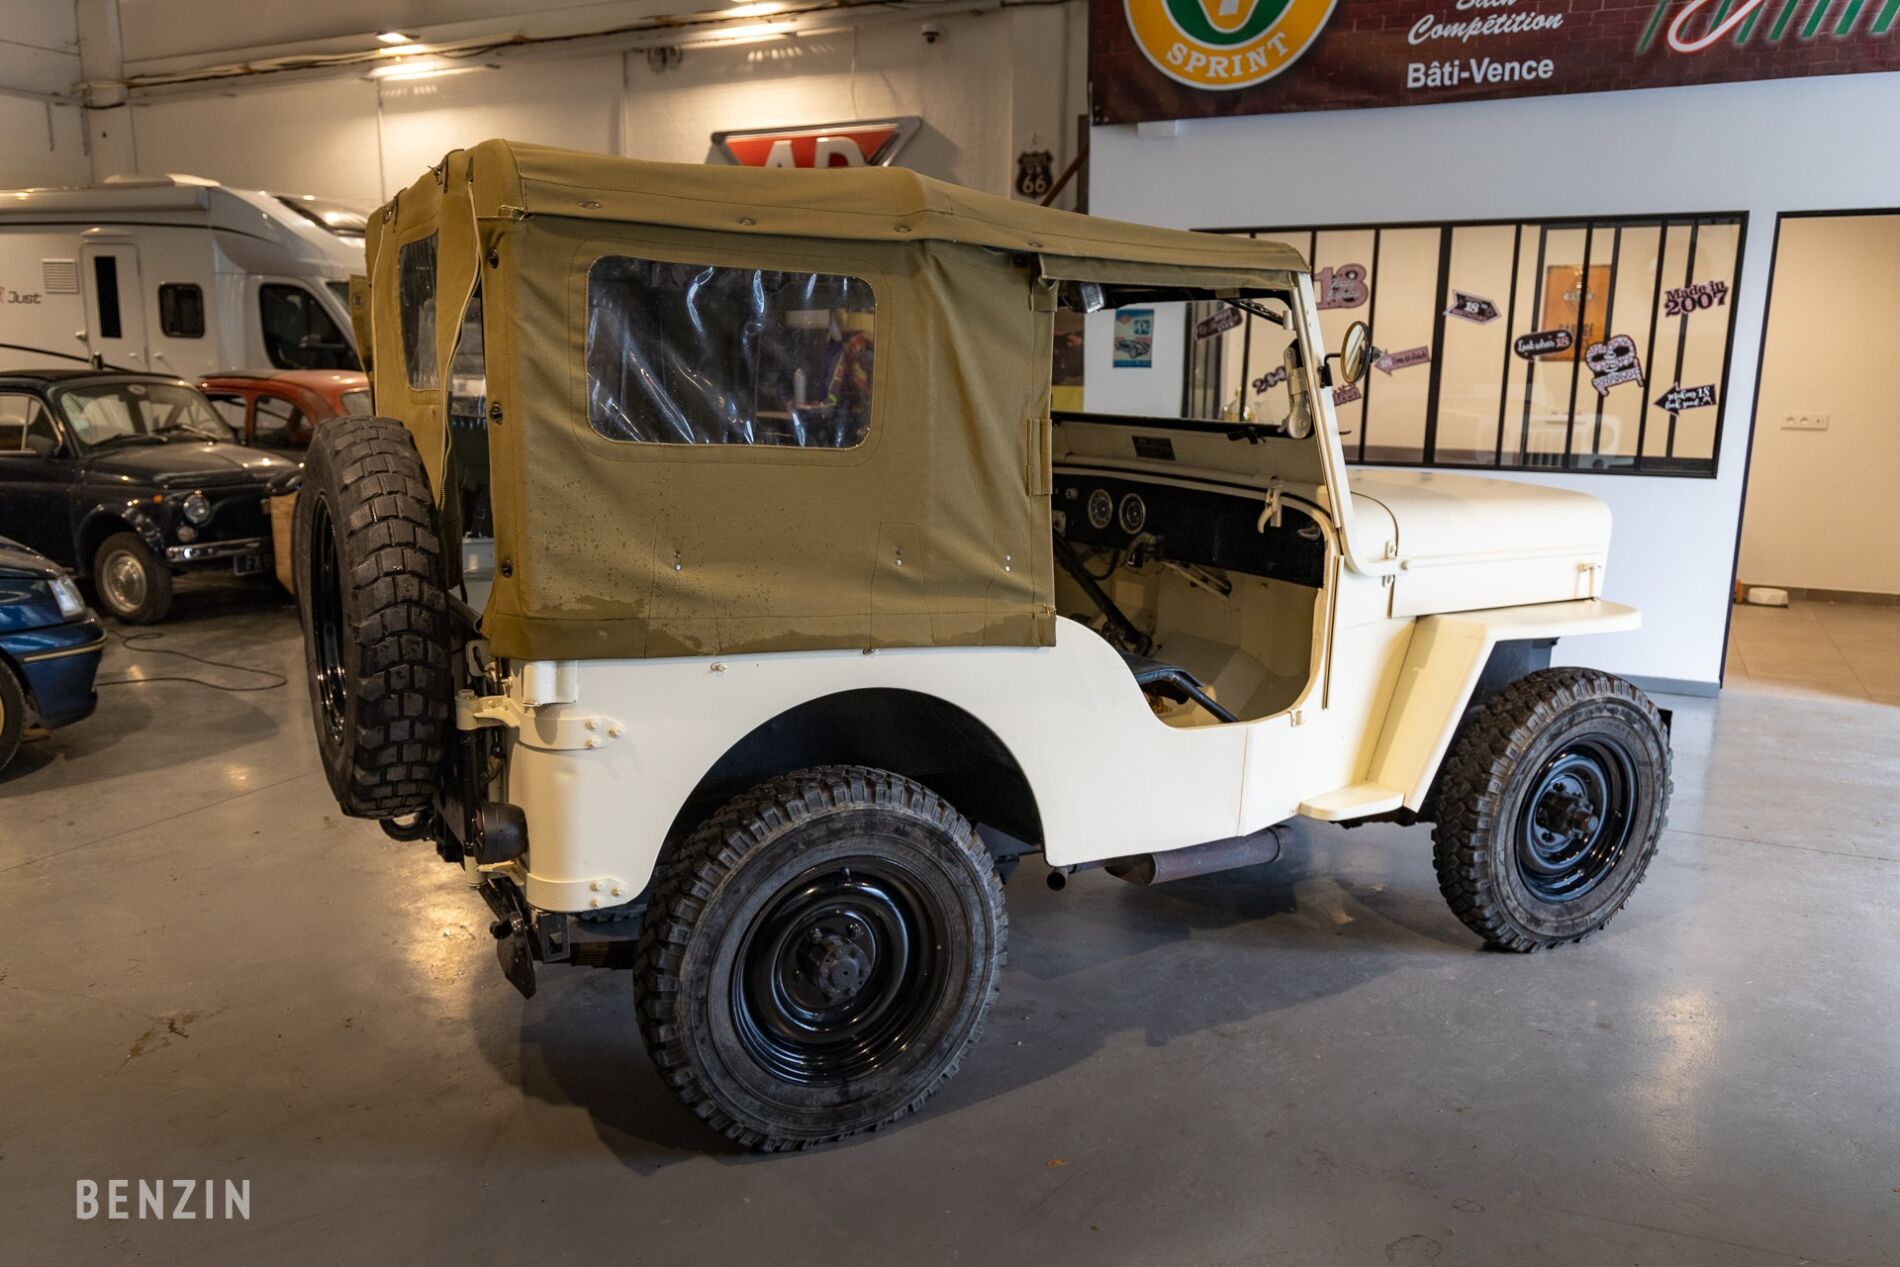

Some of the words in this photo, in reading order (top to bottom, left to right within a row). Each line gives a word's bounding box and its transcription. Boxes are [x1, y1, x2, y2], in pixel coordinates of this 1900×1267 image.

[1407, 12, 1563, 45] Compétition
[1166, 32, 1288, 78] SPRINT
[1407, 57, 1554, 89] Bâti-Vence
[1022, 175, 1046, 193] 66
[1664, 284, 1706, 300] Made
[1708, 280, 1726, 297] in
[1664, 286, 1729, 317] 2007
[1697, 386, 1711, 398] 18
